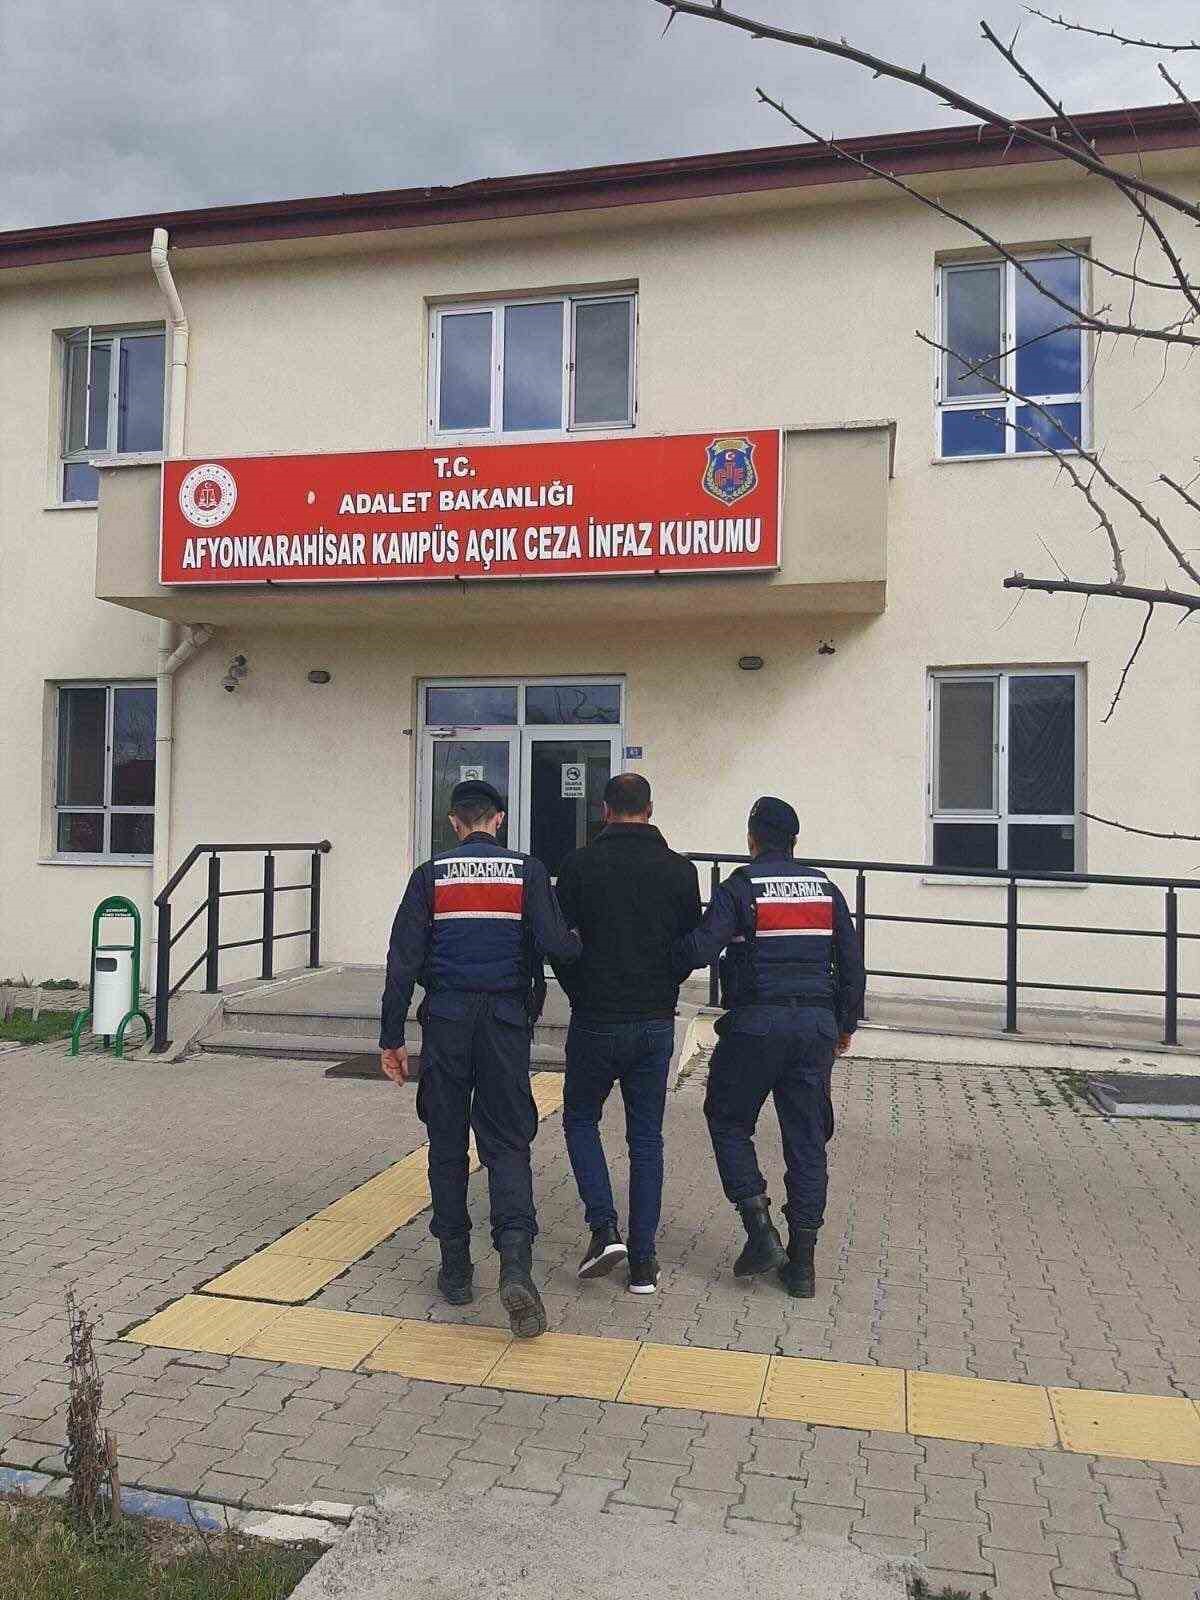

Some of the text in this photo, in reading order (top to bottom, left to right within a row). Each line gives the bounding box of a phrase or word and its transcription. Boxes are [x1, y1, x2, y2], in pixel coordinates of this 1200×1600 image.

[434, 456, 476, 477] T.C.
[339, 481, 574, 514] ADALET BAKANLIĞI
[182, 516, 761, 570] AFYONKARAHİSAR KAMPÜS AÇIK CEZA İNFAZ KURUMU
[443, 862, 516, 880] JANDARMA
[763, 882, 824, 897] JANDARMA
